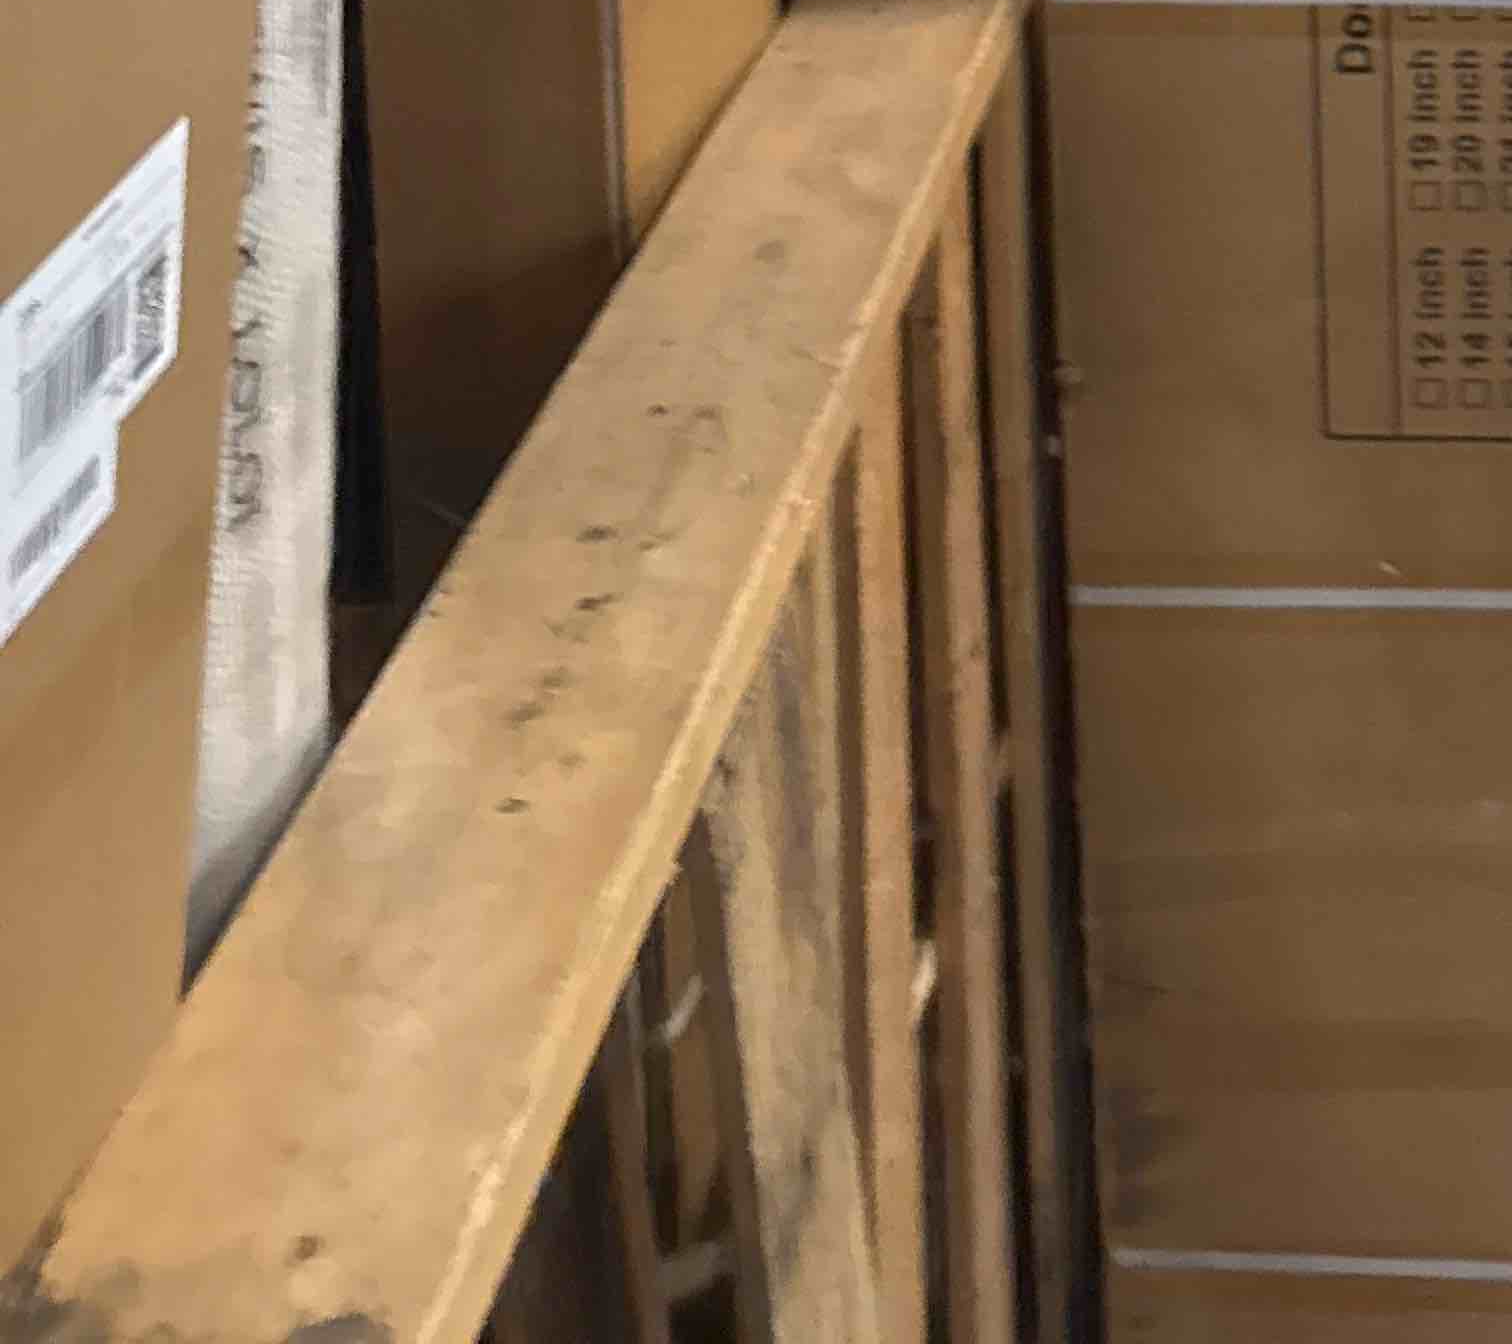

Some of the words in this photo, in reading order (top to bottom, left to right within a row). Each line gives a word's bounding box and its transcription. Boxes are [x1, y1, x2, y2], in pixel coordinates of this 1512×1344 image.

[1407, 49, 1440, 123] inch
[1452, 49, 1485, 123] inch
[1409, 135, 1440, 170] 19
[1453, 135, 1486, 173] 20
[1412, 246, 1446, 320] inch
[1459, 246, 1493, 320] inch
[1415, 332, 1447, 368] 12
[1459, 332, 1493, 369] 14
